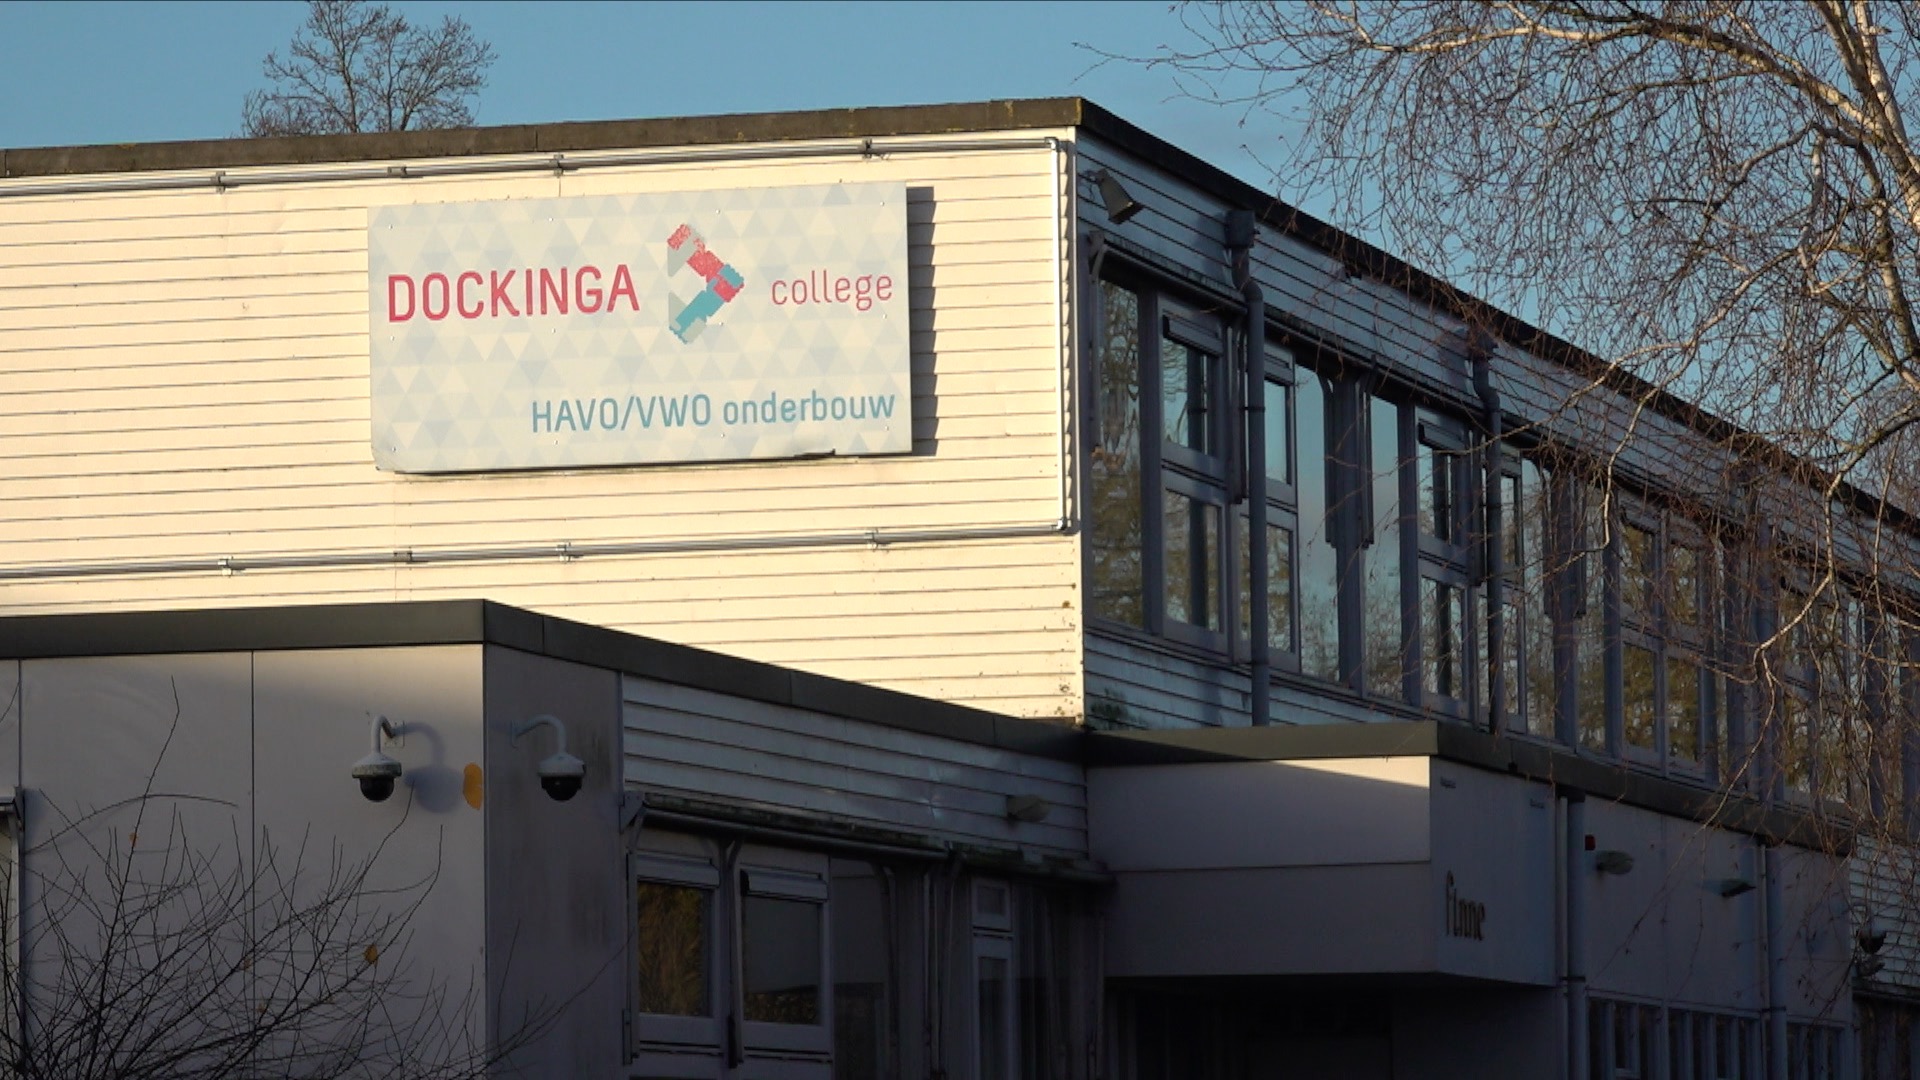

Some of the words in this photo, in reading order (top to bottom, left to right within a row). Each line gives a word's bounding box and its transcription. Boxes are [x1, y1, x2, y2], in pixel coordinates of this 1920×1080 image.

[388, 264, 640, 323] DOCKINGA
[771, 271, 893, 311] college
[532, 394, 711, 433] HAVO/VWO
[723, 390, 896, 425] onderbouw
